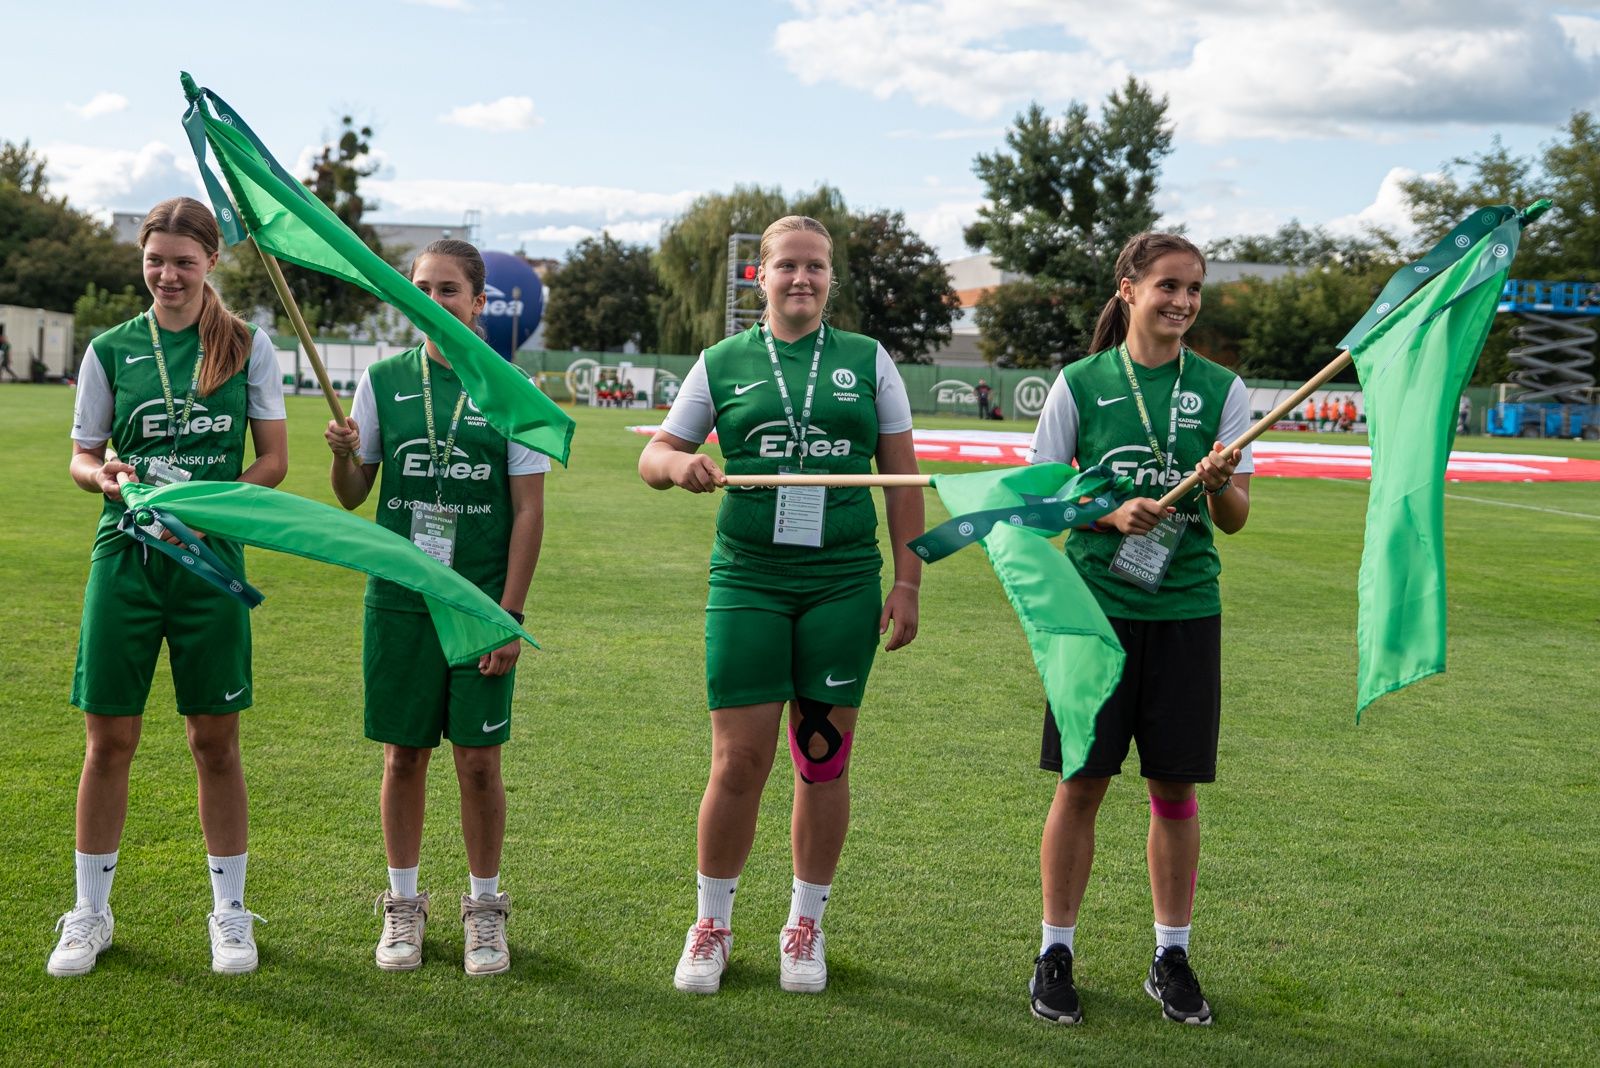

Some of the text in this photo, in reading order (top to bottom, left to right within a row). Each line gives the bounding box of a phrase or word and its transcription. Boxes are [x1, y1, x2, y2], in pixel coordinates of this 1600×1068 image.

[483, 299, 525, 317] ea
[937, 389, 978, 404] Ene
[467, 420, 487, 428] WARTY
[1178, 417, 1202, 425] KADEMIA
[759, 434, 851, 458] Enea
[144, 453, 204, 466] POZNAŃSKI
[404, 499, 492, 514] POZNAŃSKI BANK
[1175, 512, 1201, 523] BANK
